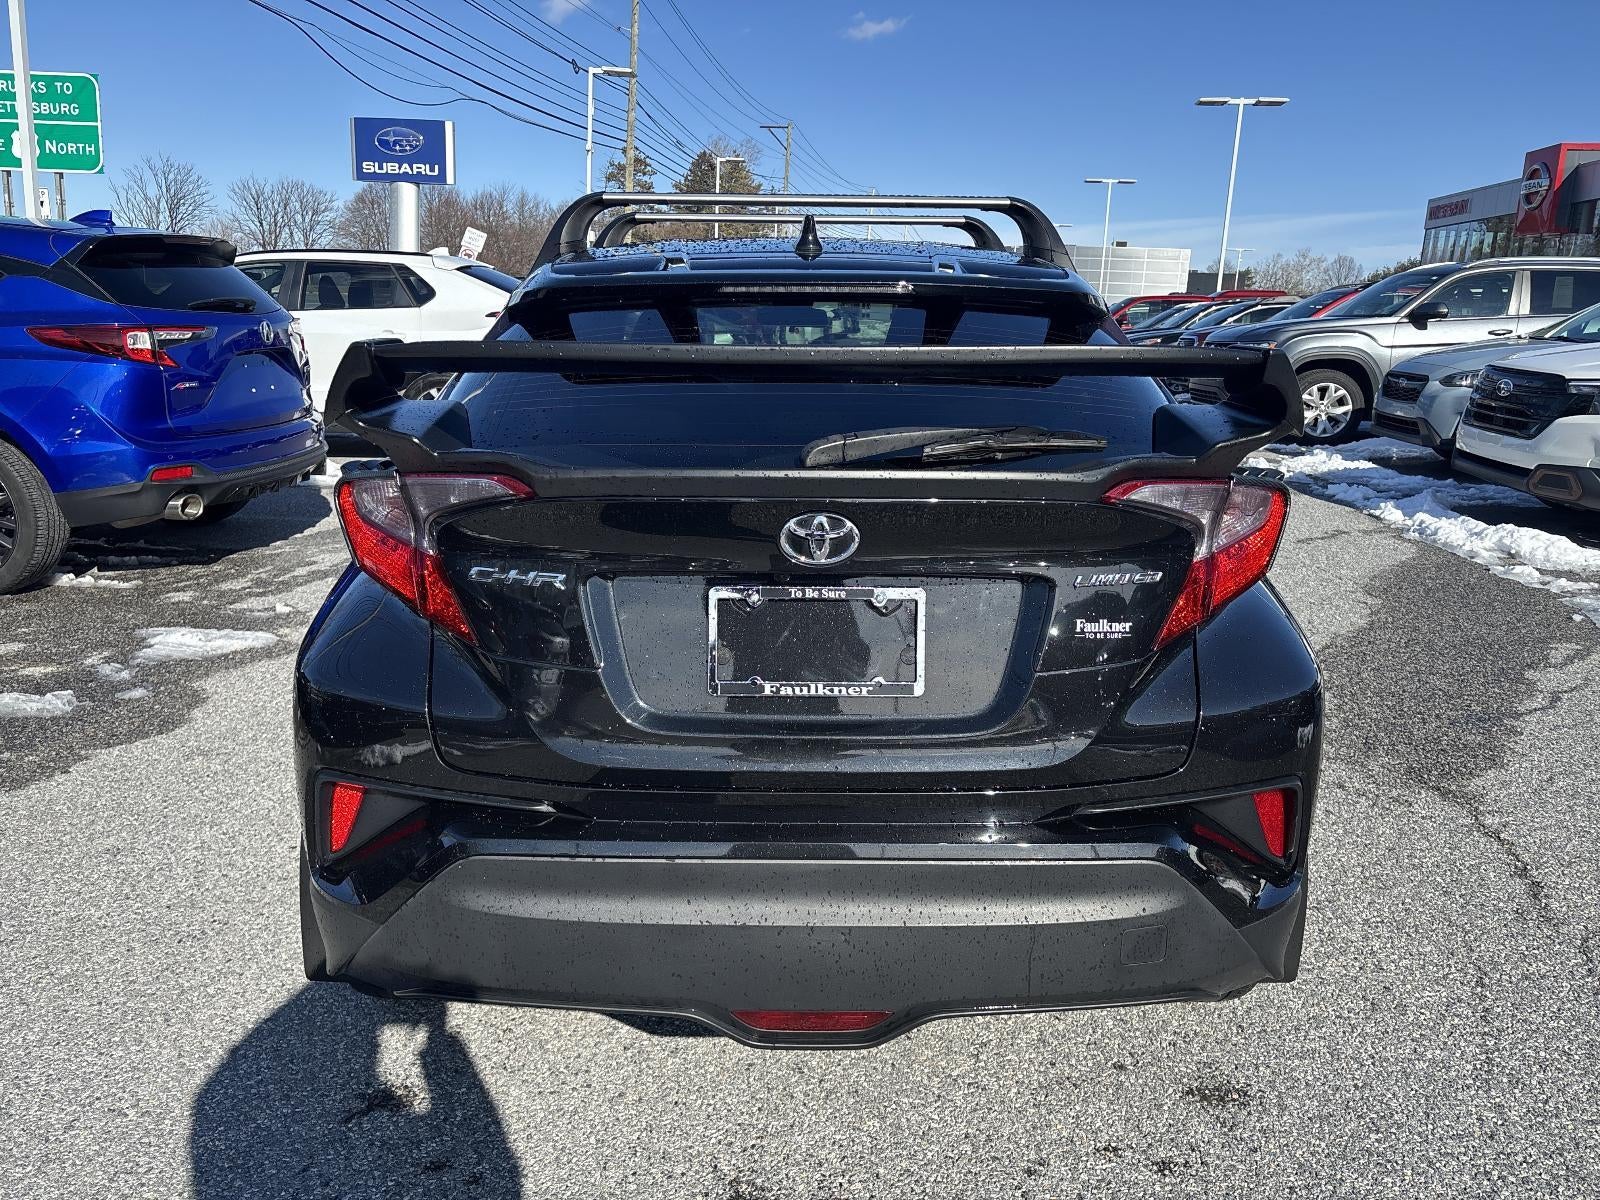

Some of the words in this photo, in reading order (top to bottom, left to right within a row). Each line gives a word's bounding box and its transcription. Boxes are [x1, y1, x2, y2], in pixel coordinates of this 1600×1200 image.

[0, 80, 47, 94] RUKS
[54, 82, 73, 95] TO
[0, 100, 80, 116] ETTSBURG
[45, 139, 96, 156] NORTH
[362, 161, 439, 176] SUBARU
[467, 566, 567, 591] C-HR
[1073, 571, 1163, 589] LIMITED
[789, 588, 803, 598] To
[805, 588, 820, 598] Be
[821, 588, 847, 599] Sure
[1075, 618, 1133, 633] Faulkner
[761, 683, 874, 696] Faulkner
